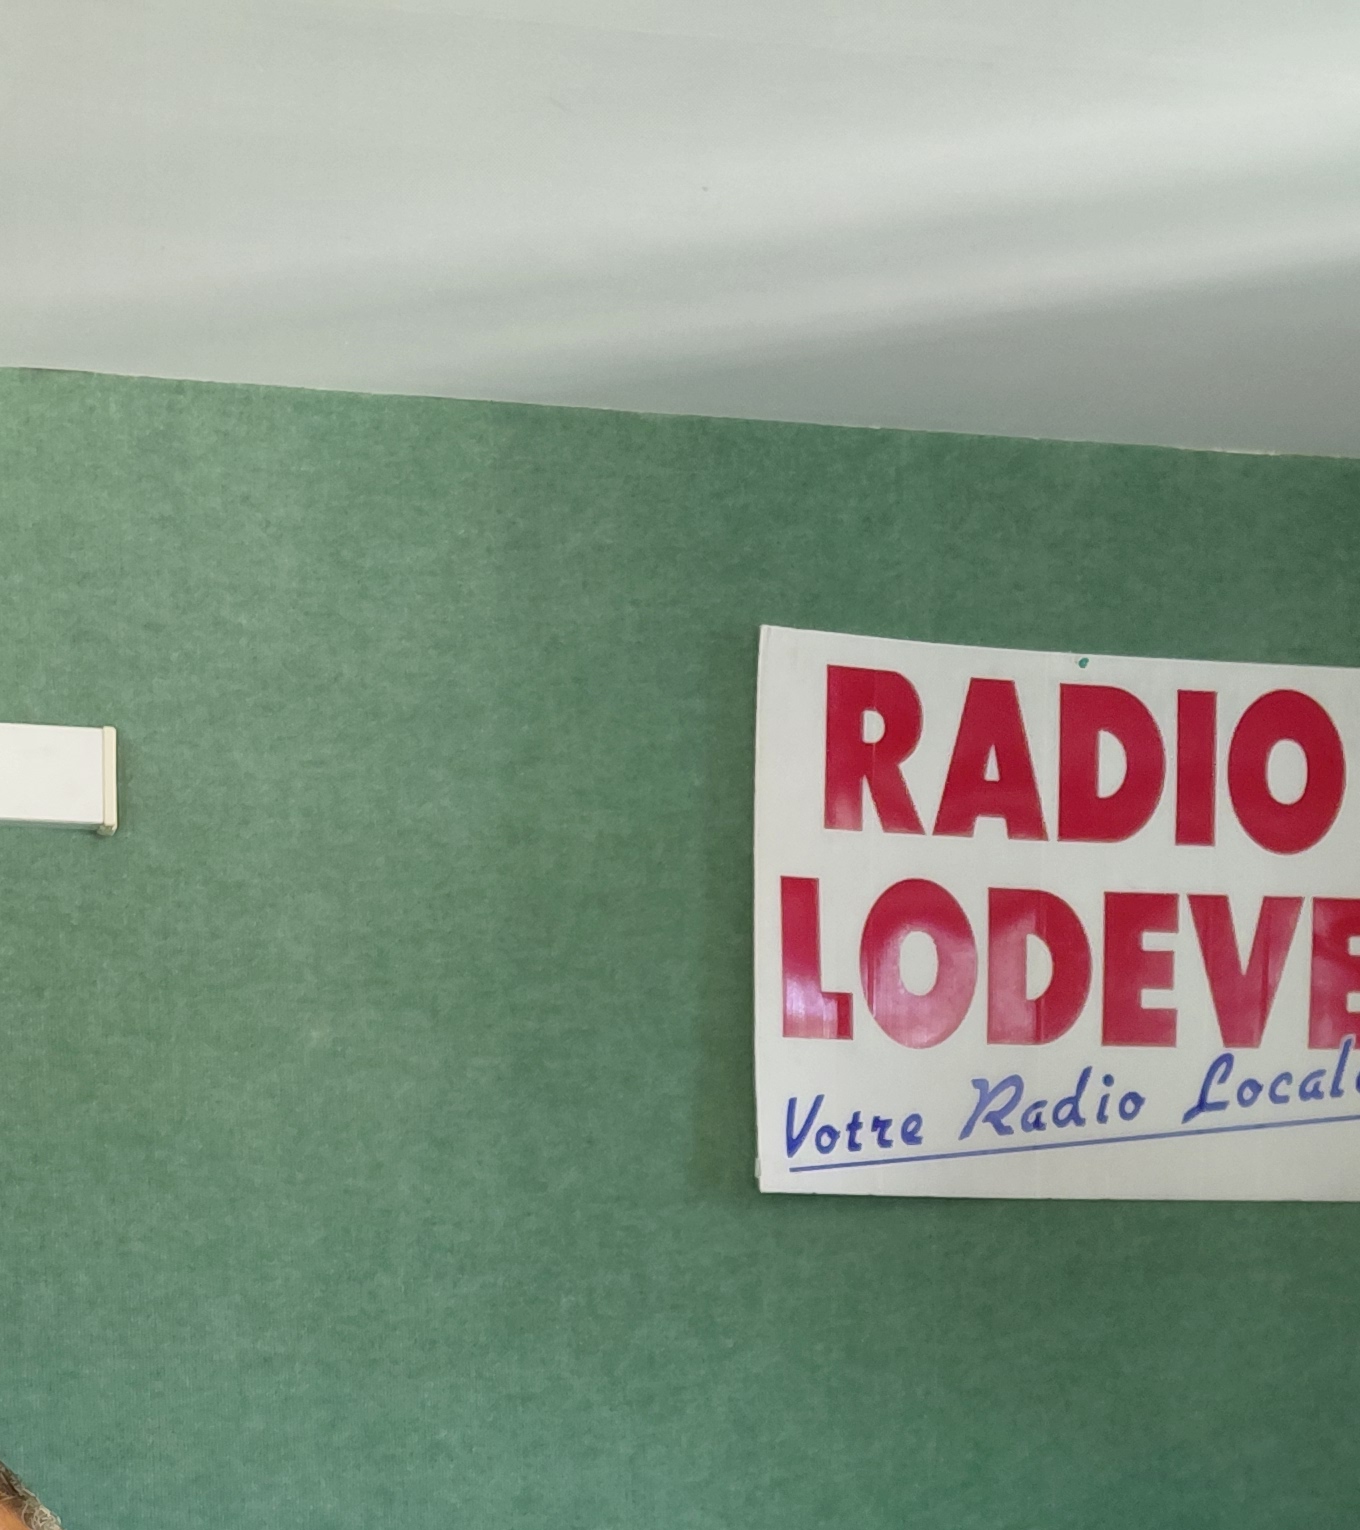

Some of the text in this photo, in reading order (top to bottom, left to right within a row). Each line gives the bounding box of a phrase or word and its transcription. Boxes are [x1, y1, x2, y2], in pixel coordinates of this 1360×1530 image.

[824, 664, 1346, 854] RADIO
[785, 1094, 923, 1160] Votre
[960, 1067, 1147, 1142] Radio
